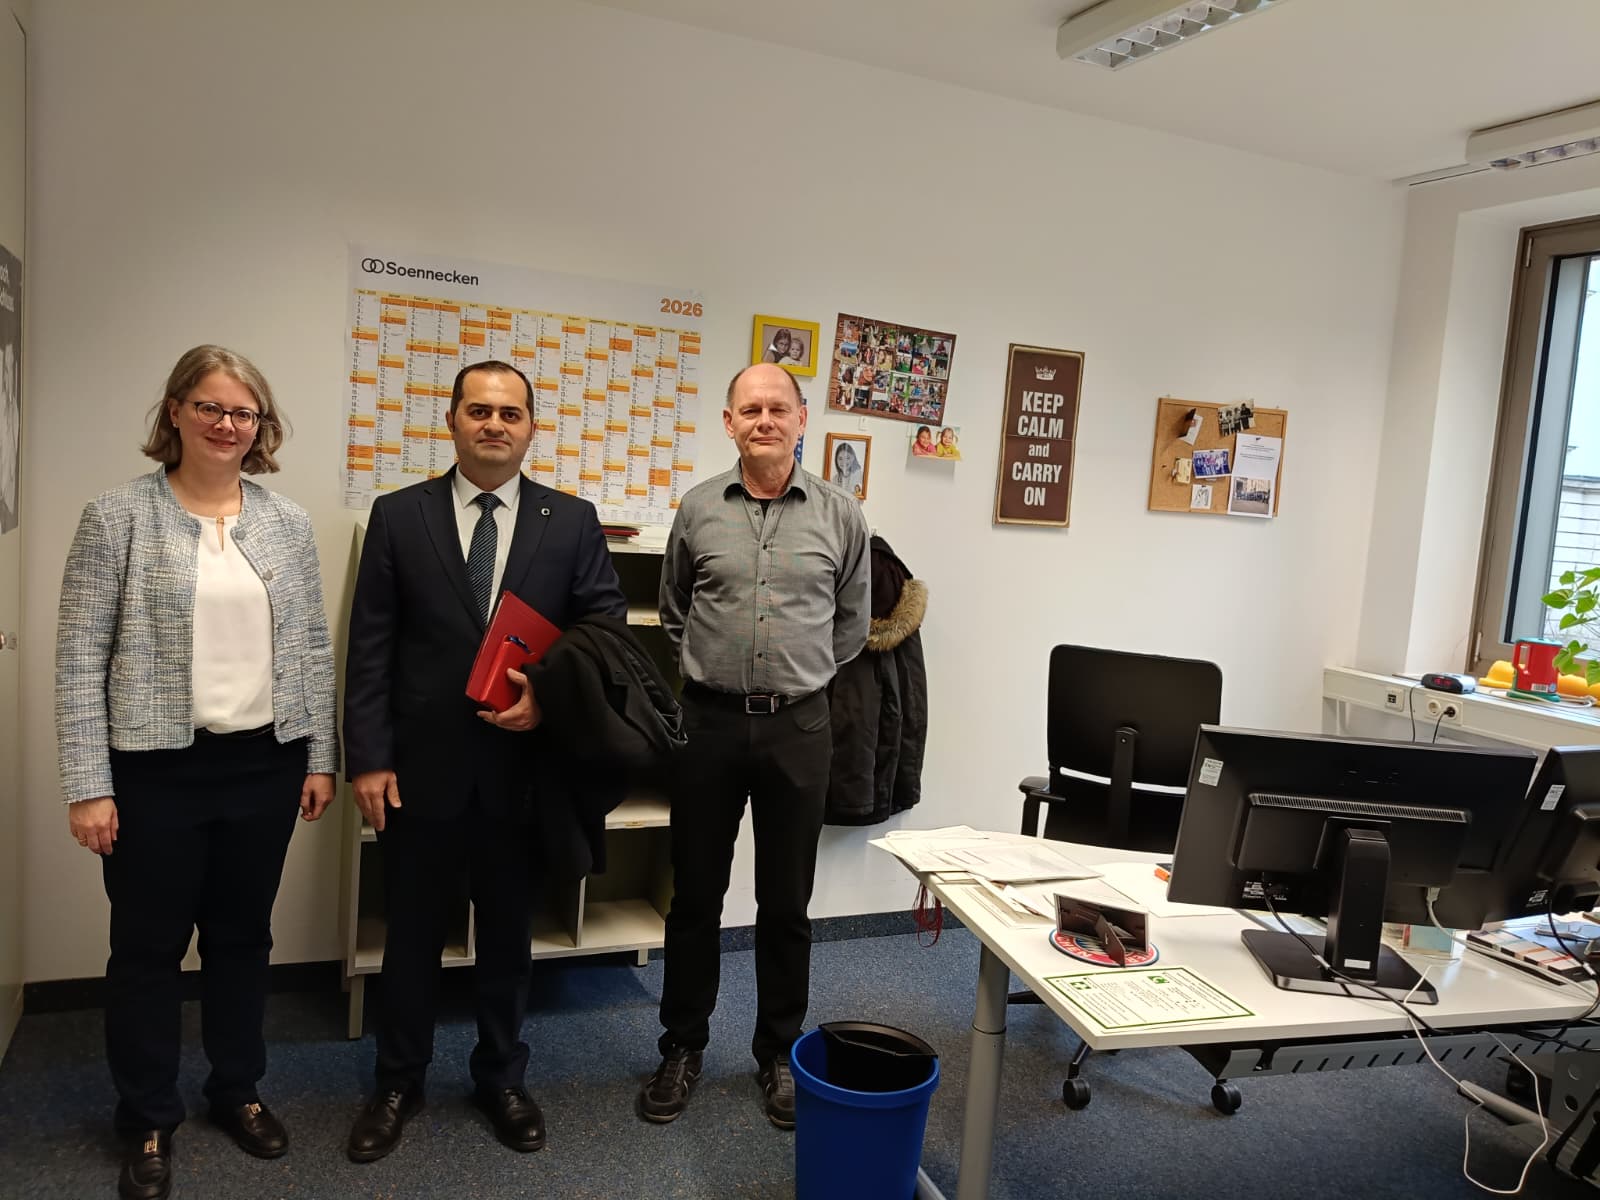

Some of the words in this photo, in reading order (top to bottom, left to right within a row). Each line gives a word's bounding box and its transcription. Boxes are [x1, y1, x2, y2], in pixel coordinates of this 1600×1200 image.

[385, 261, 480, 286] Soennecken
[660, 297, 704, 318] 2026
[1021, 390, 1064, 414] KEEP
[1017, 415, 1064, 438] CALM
[1028, 442, 1050, 458] and
[1011, 461, 1063, 484] CARRY
[1023, 486, 1046, 506] ON
